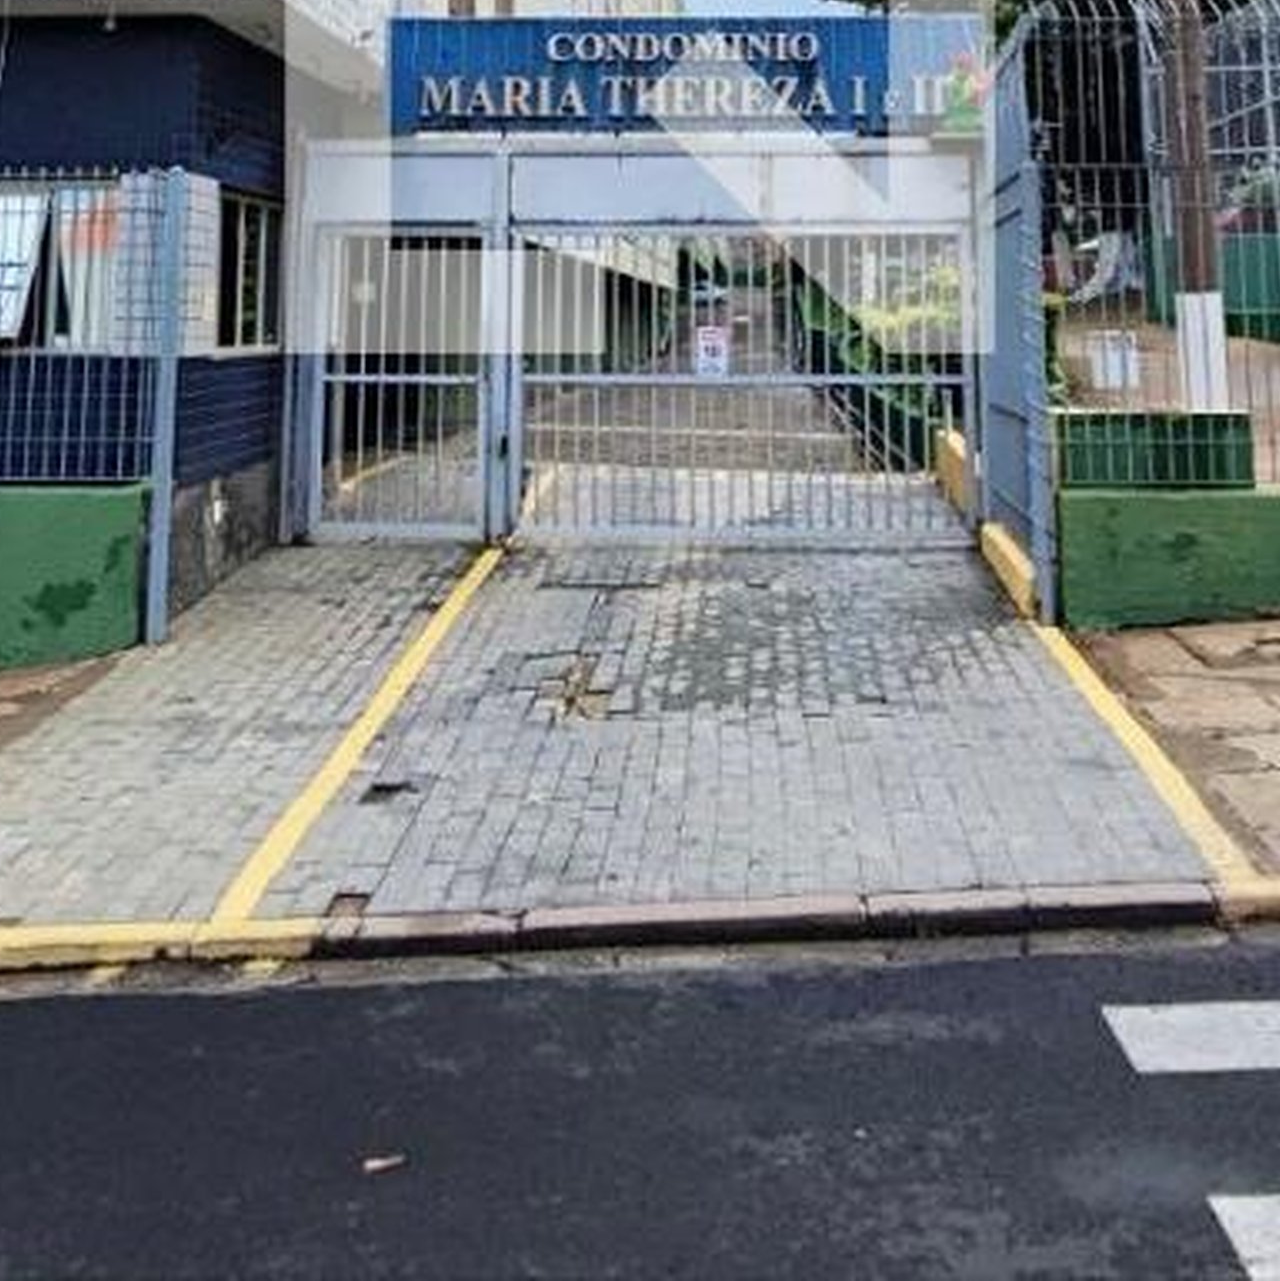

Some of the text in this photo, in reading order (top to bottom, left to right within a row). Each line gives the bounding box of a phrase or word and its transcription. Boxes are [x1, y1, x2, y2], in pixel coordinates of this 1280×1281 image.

[547, 32, 818, 62] CONDOMINIO
[421, 76, 588, 117] MARIA
[600, 76, 836, 117] THEREZA
[852, 76, 867, 116] I
